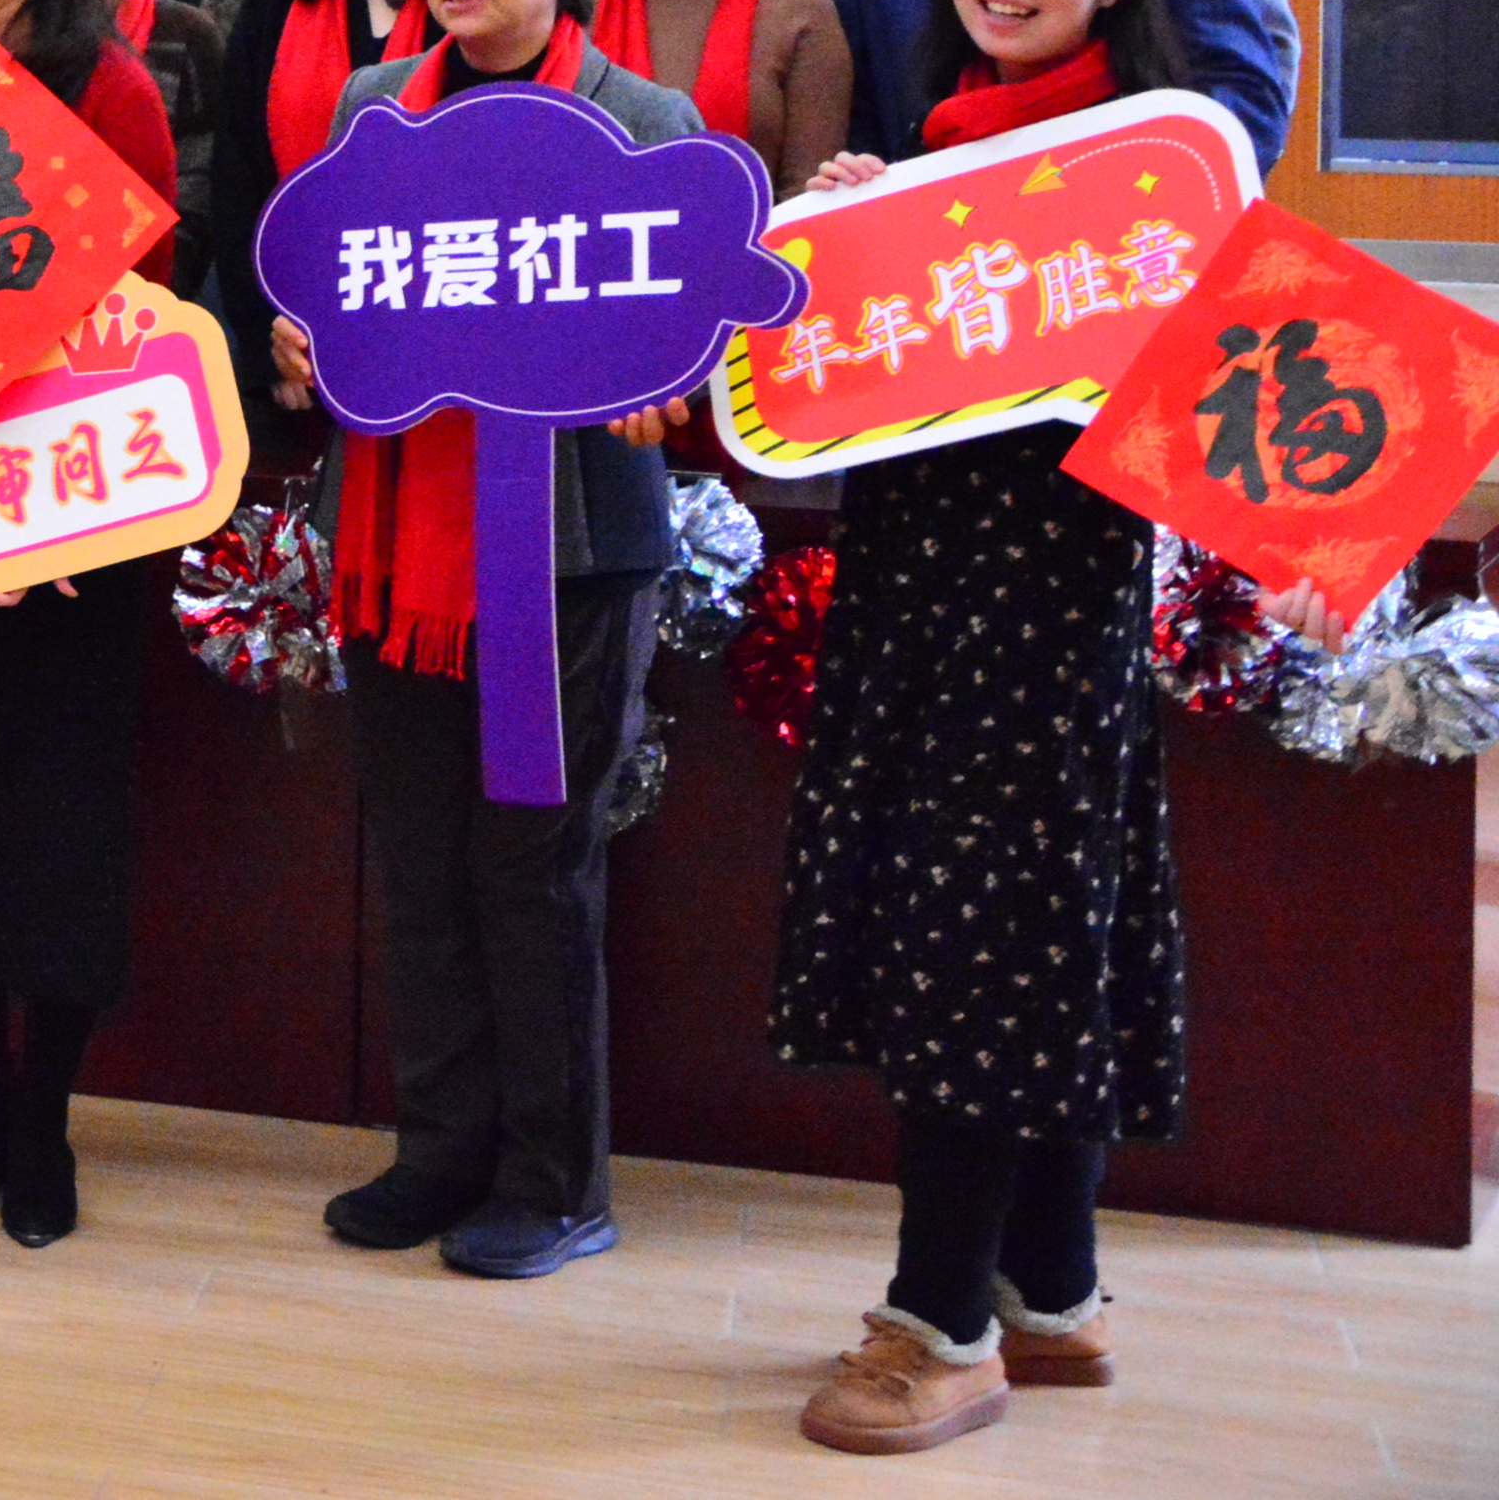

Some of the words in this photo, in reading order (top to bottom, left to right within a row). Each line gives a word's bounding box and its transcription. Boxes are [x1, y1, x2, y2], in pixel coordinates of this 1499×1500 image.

[337, 208, 684, 311] 我爱社工
[774, 220, 1198, 393] 年年皆胜意
[1191, 317, 1389, 504] 福
